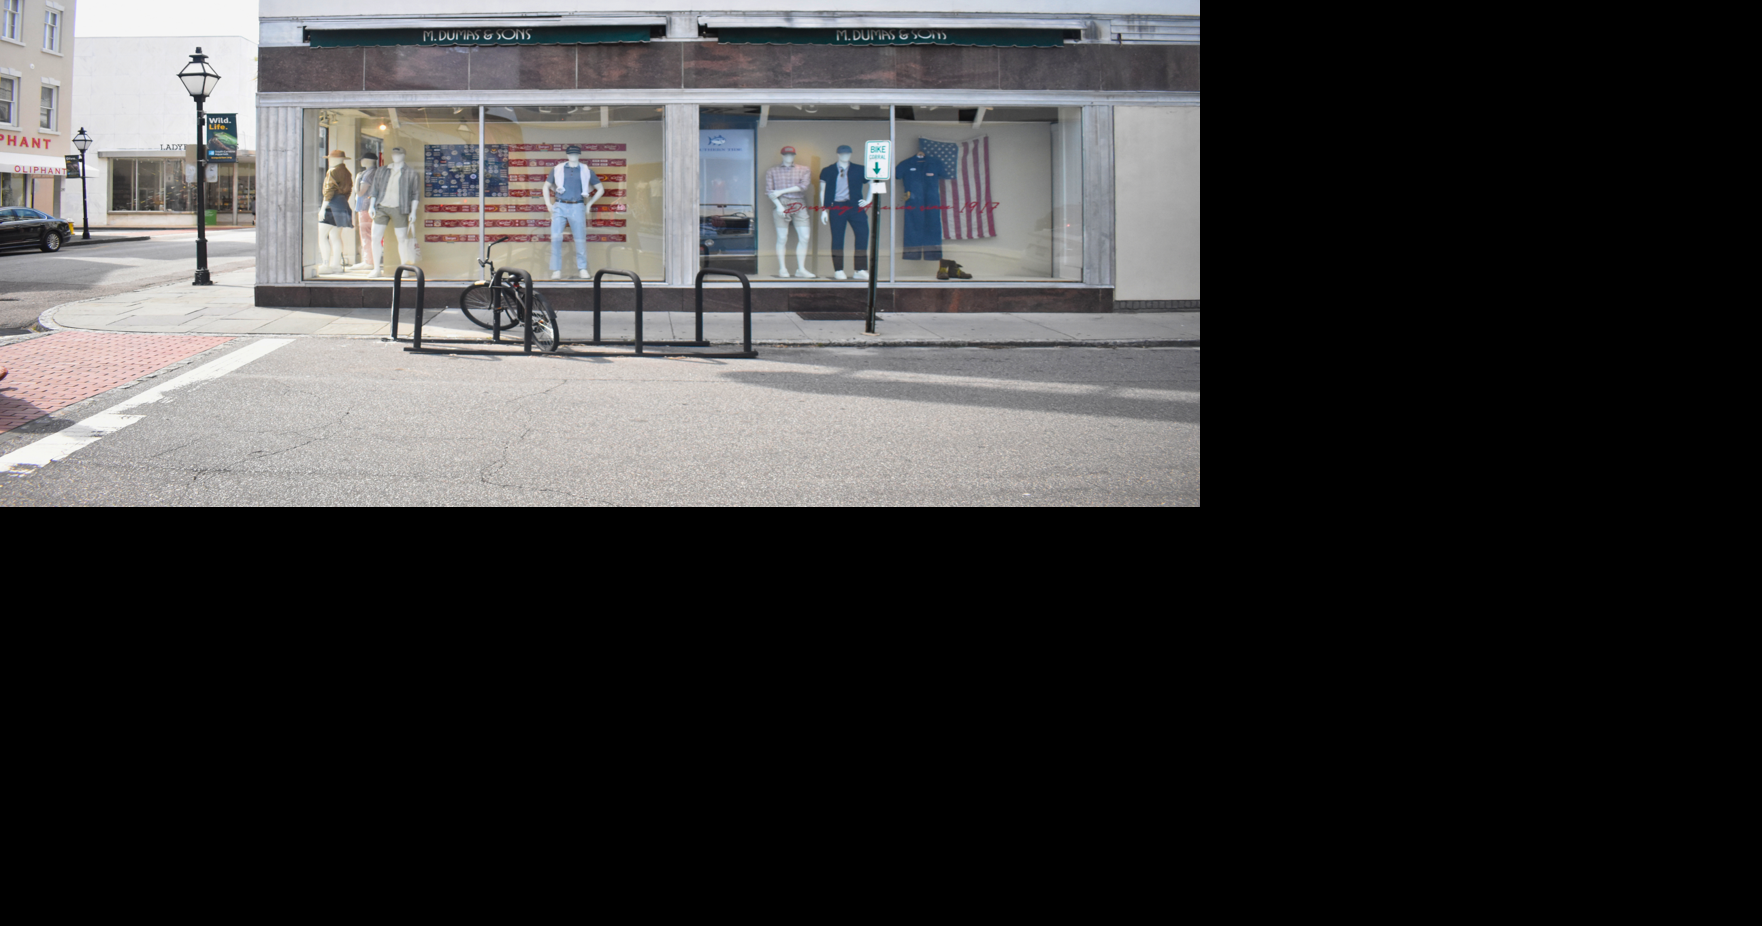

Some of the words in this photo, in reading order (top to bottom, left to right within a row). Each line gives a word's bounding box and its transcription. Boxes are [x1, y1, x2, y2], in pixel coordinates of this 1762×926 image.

[423, 30, 437, 42] M.
[438, 29, 482, 41] DUMAS
[483, 29, 494, 40] &
[495, 28, 533, 40] SONS
[836, 29, 851, 41] M.
[852, 29, 896, 41] DUMAS
[898, 29, 909, 40] &
[910, 29, 947, 40] SONS
[870, 145, 886, 153] BIKE
[14, 165, 67, 175] OLIPHANT
[959, 201, 1000, 214] 1917
